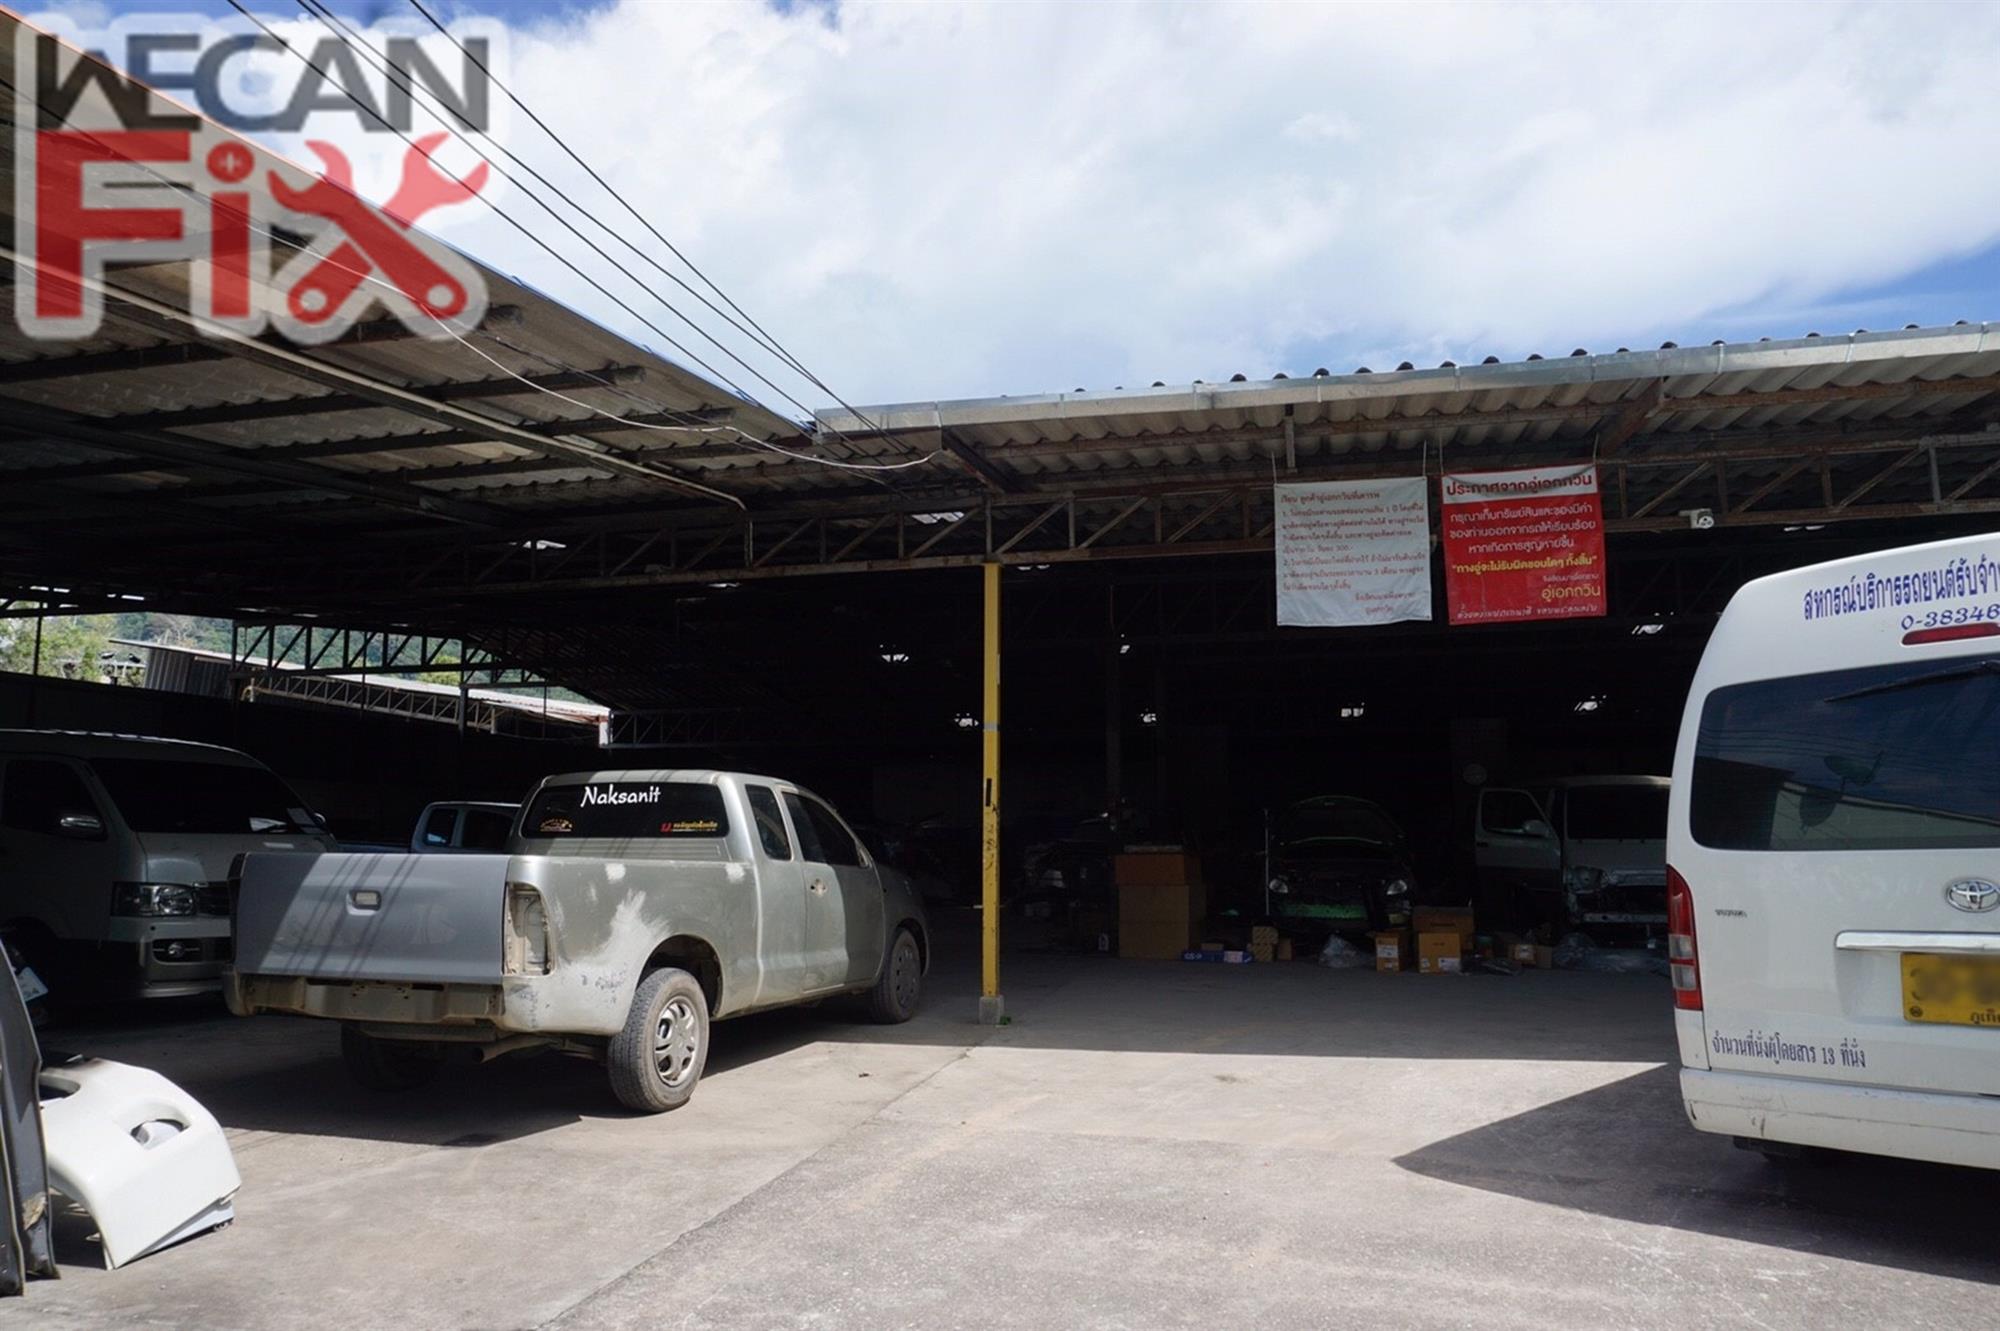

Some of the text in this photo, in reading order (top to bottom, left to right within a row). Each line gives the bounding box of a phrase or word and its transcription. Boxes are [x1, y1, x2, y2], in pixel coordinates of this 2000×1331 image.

[1803, 554, 2000, 620] สหกรณ์บริการรถยนต์รับจ้า
[580, 784, 661, 808] Naksanit
[1712, 1030, 1867, 1068] จำนวนที่นั่งผู้โดยสาร 13 ที่นั่ง
